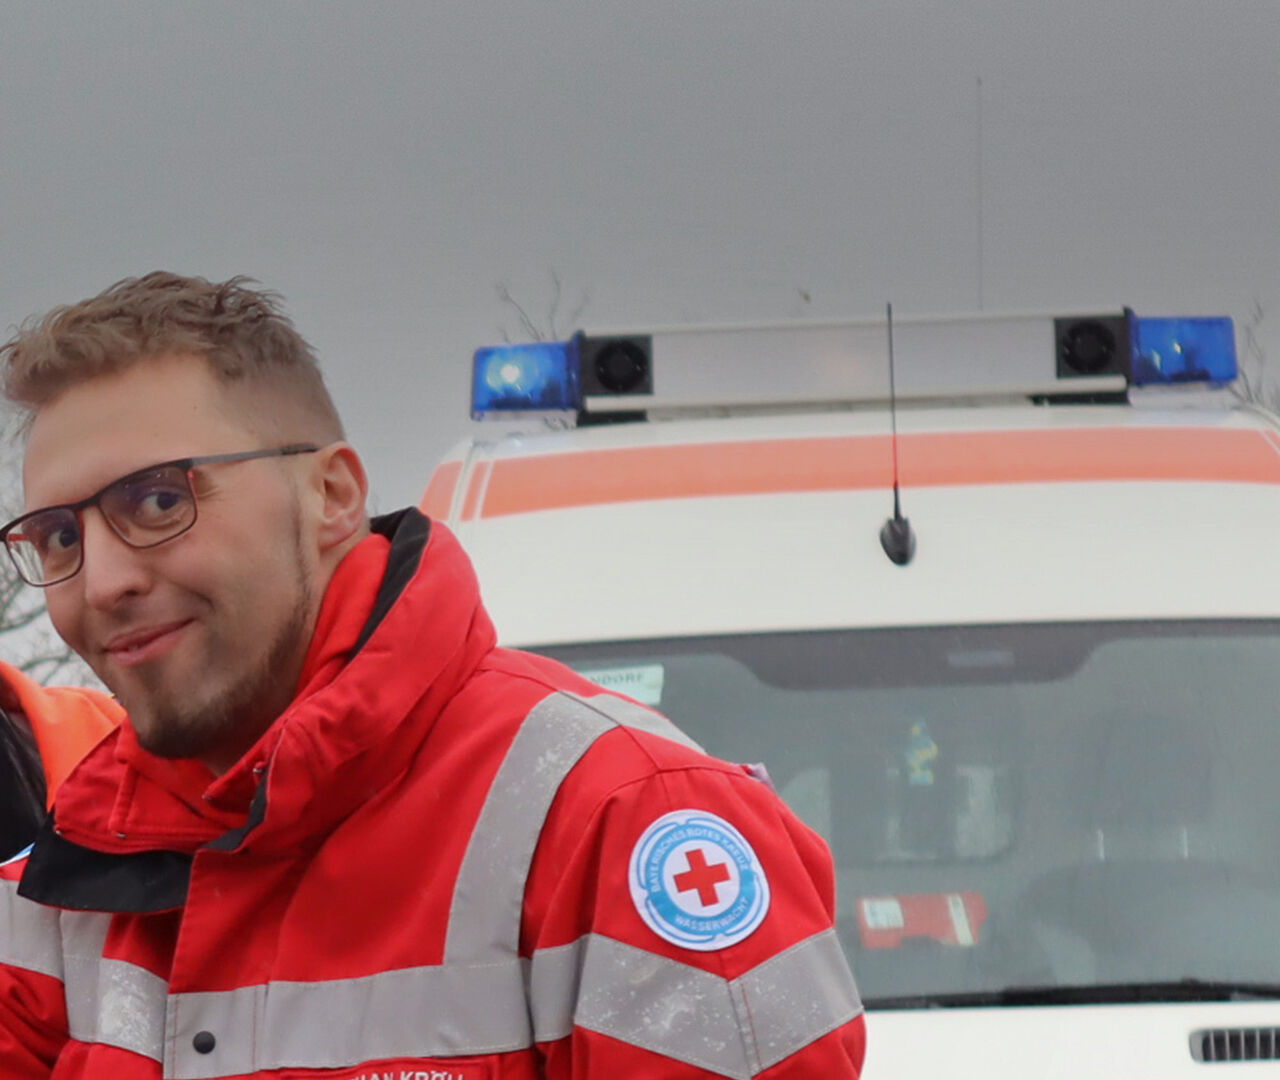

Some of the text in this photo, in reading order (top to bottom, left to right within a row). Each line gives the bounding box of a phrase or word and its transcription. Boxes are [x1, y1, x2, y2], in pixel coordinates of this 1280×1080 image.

[686, 826, 721, 842] ROTES
[722, 838, 750, 871] KREUZ
[675, 897, 749, 931] WASSERWACHT
